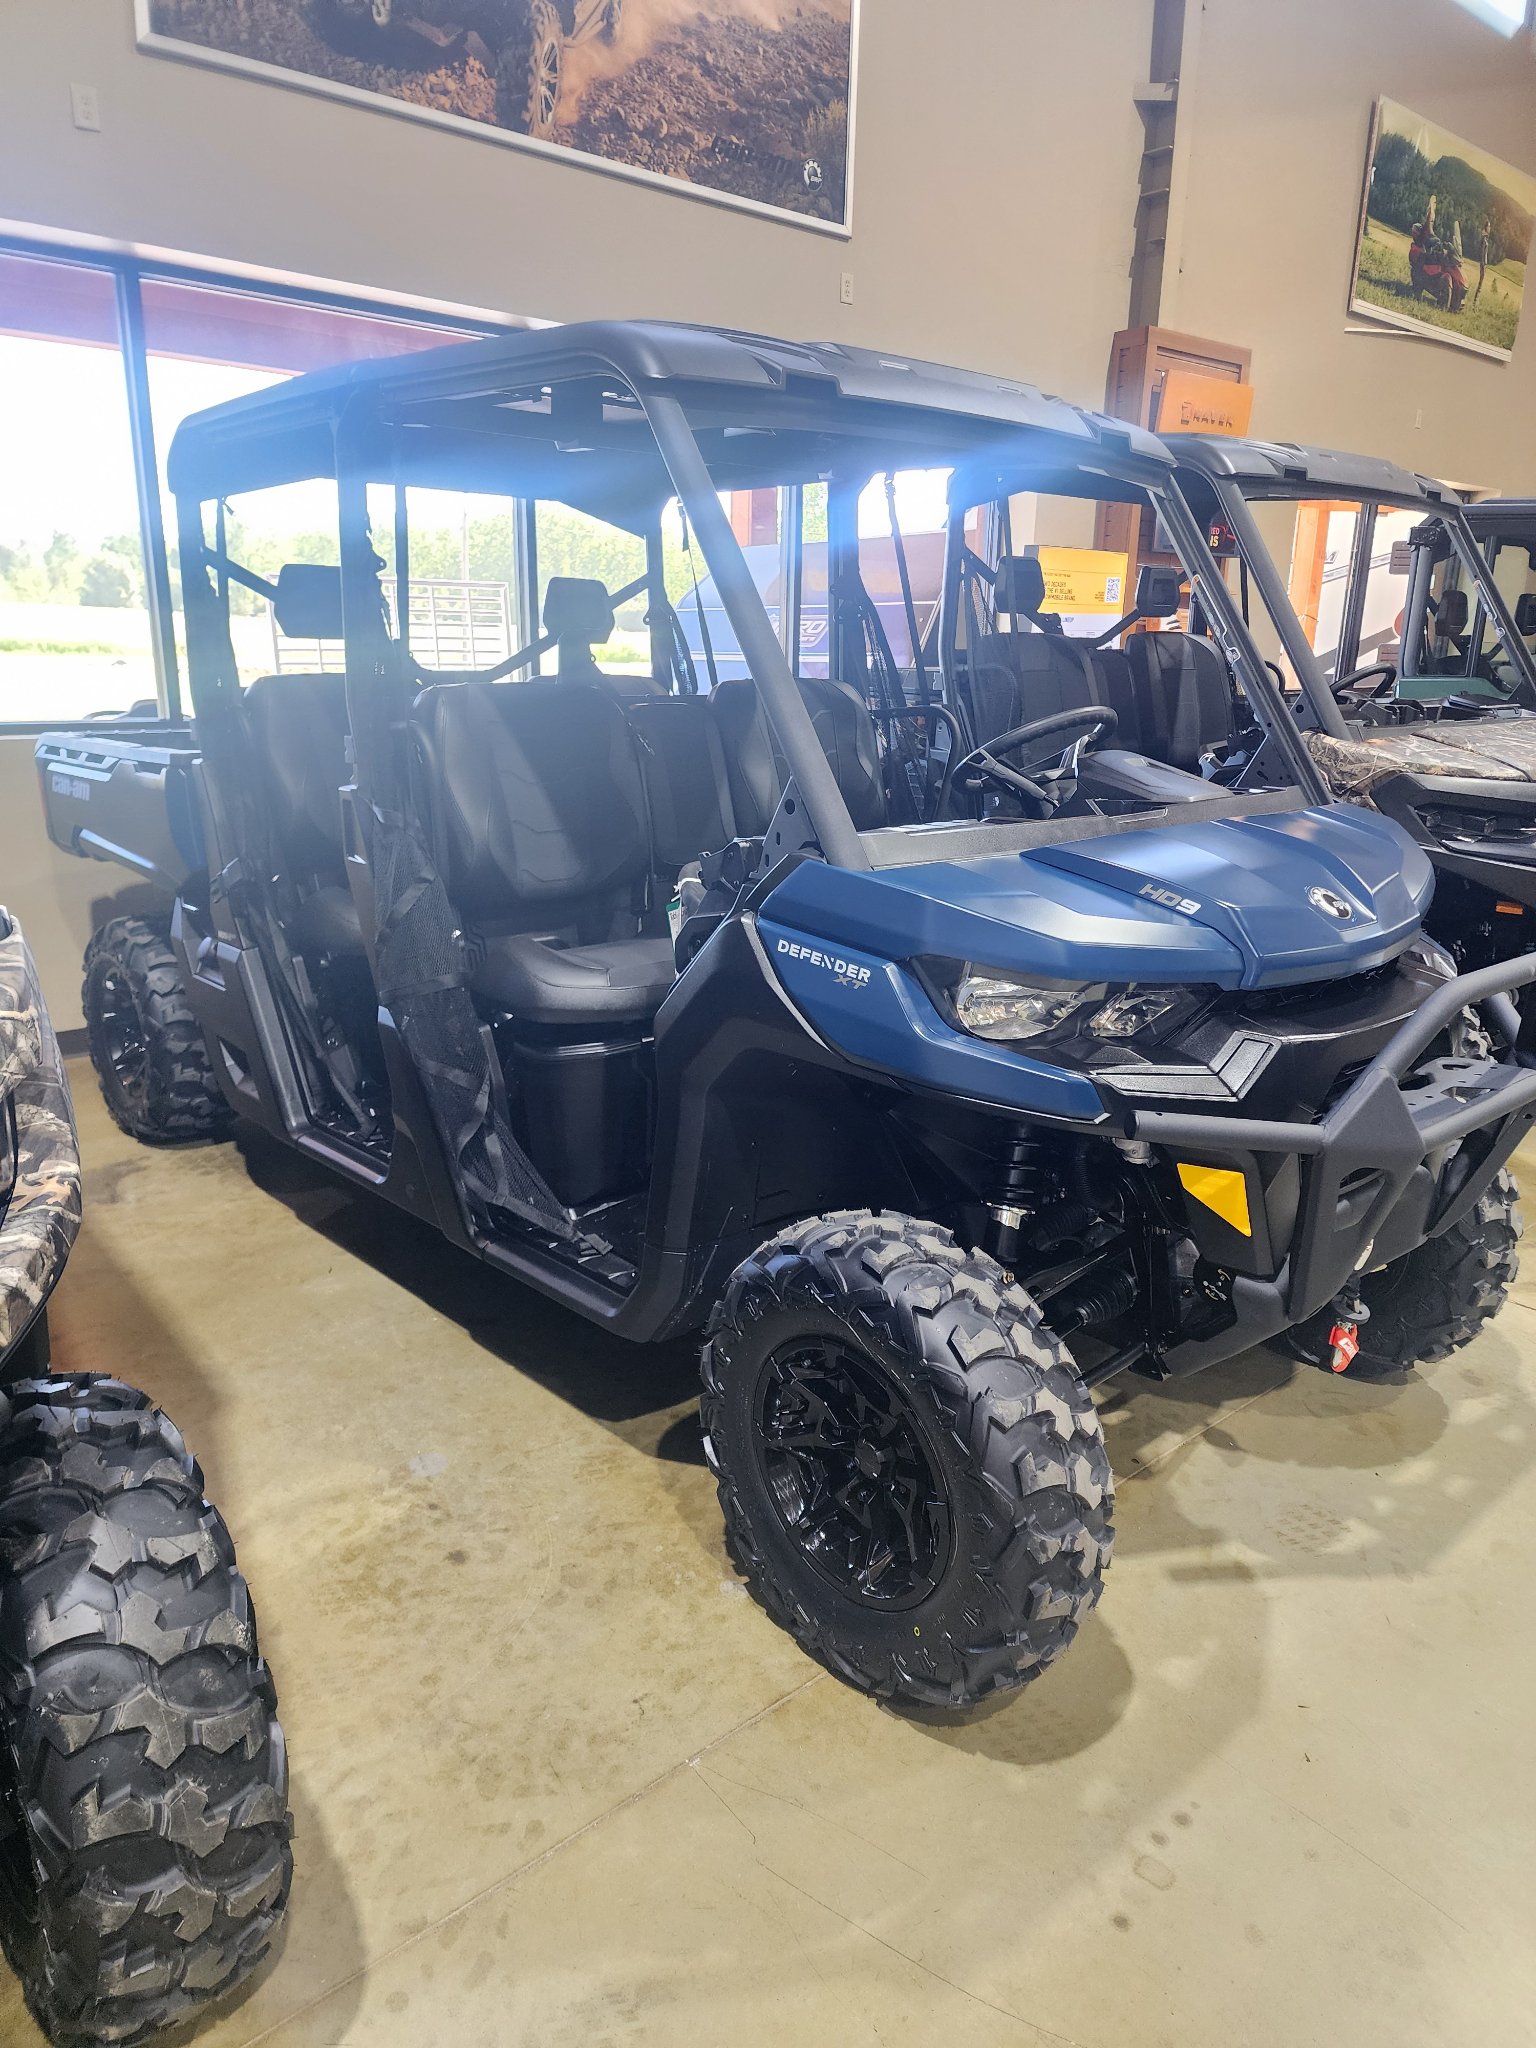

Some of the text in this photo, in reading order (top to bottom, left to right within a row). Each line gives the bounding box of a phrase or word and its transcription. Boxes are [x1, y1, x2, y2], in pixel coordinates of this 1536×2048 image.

[1138, 883, 1201, 915] HD9
[777, 939, 871, 983] DEFENDER
[832, 974, 867, 990] XT
